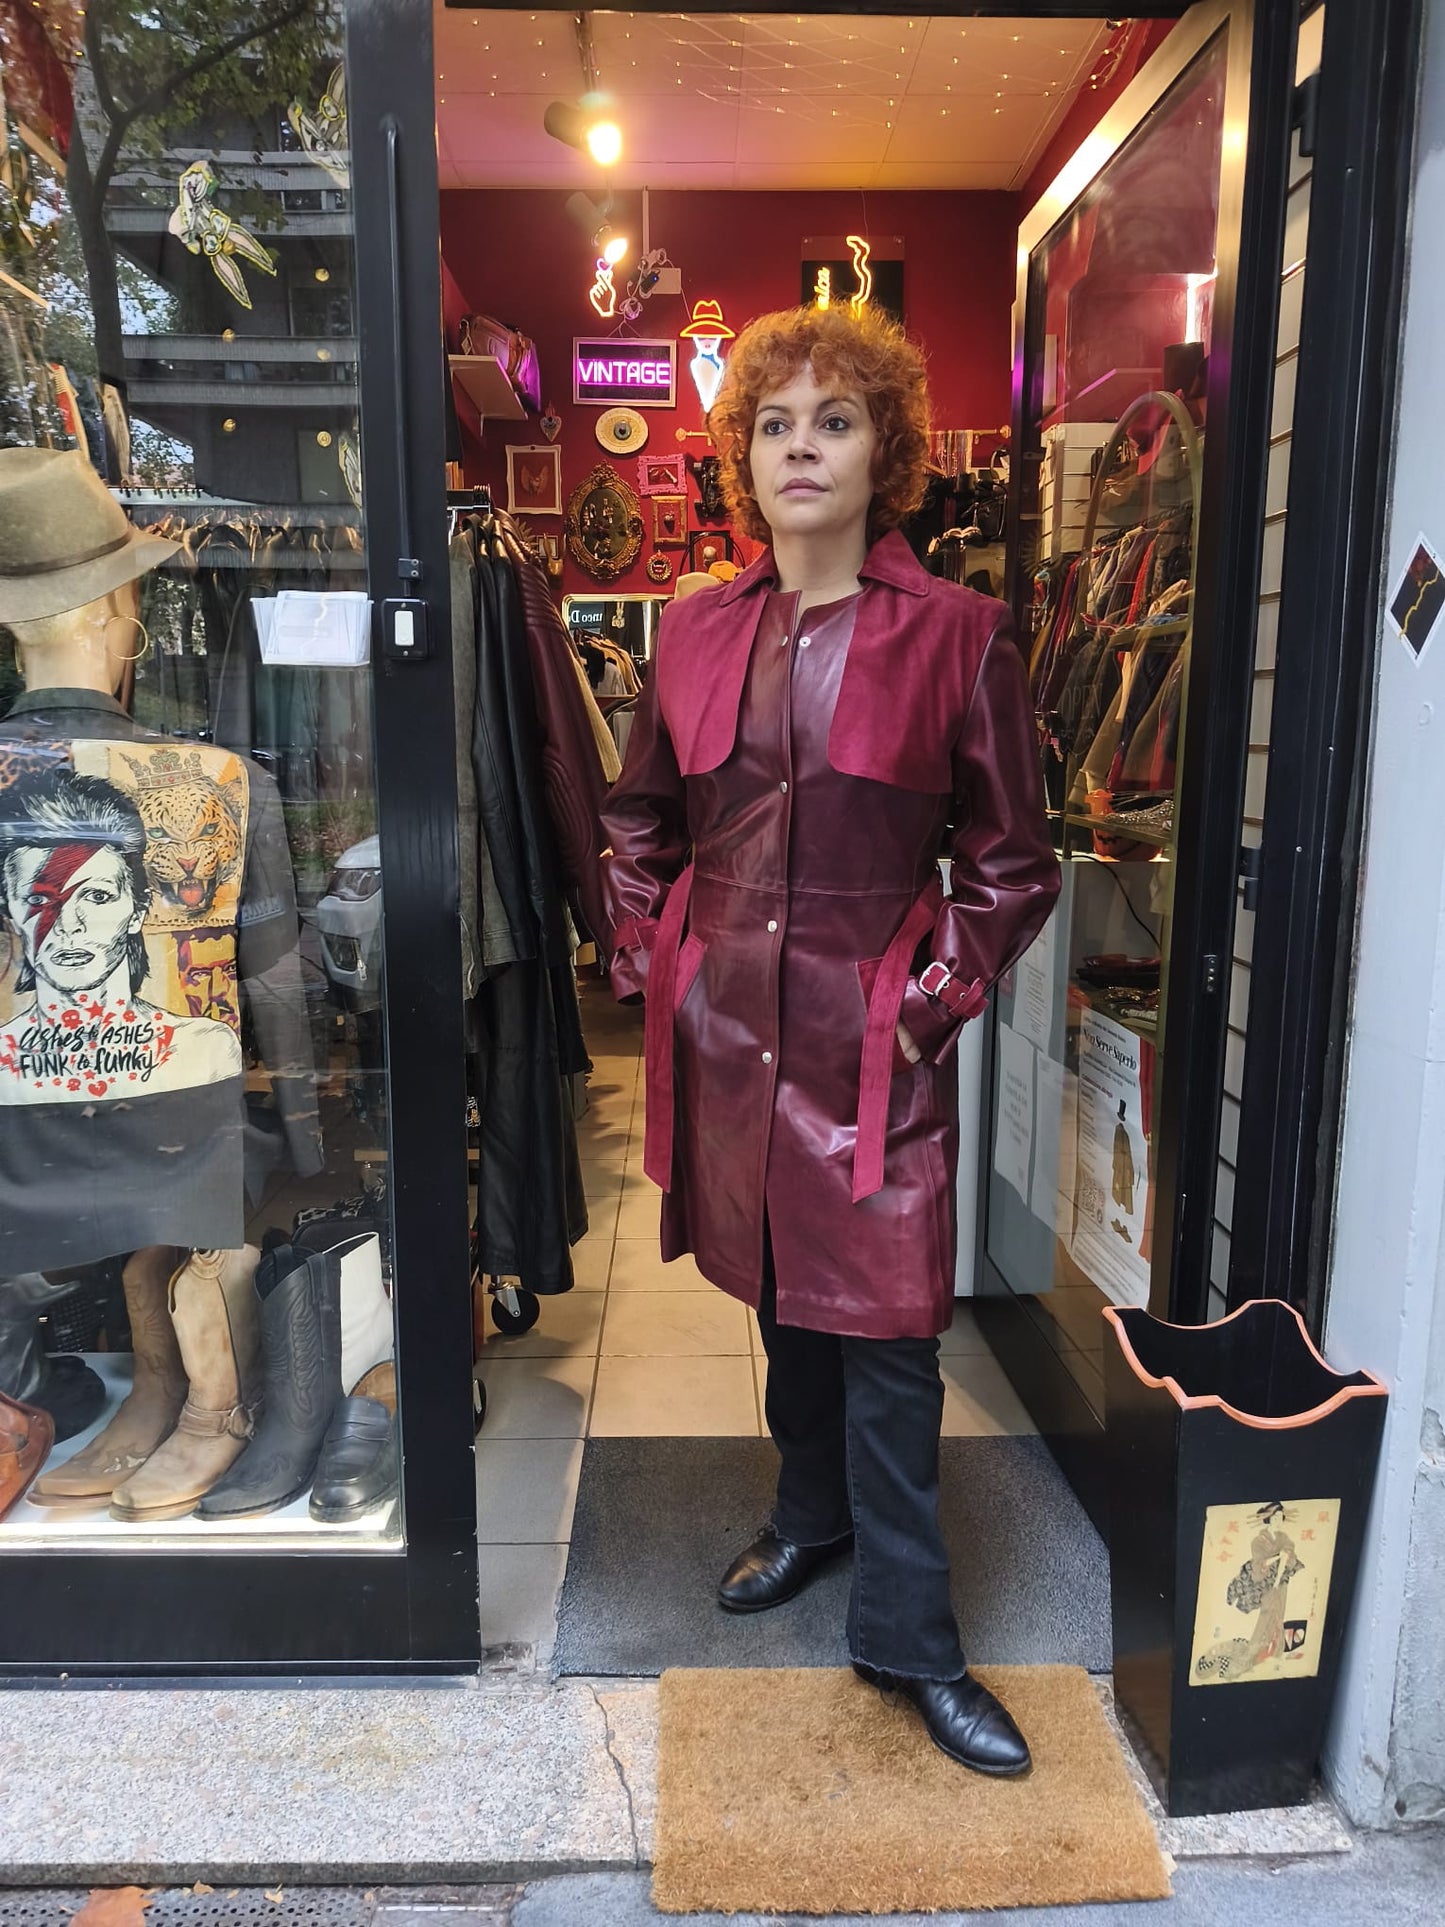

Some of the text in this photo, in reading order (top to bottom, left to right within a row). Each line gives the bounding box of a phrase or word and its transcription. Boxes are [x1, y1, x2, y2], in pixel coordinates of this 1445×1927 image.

[578, 361, 671, 384] VINTAGE
[101, 1021, 154, 1045] ASHES
[20, 1046, 159, 1082] FUNK to funky
